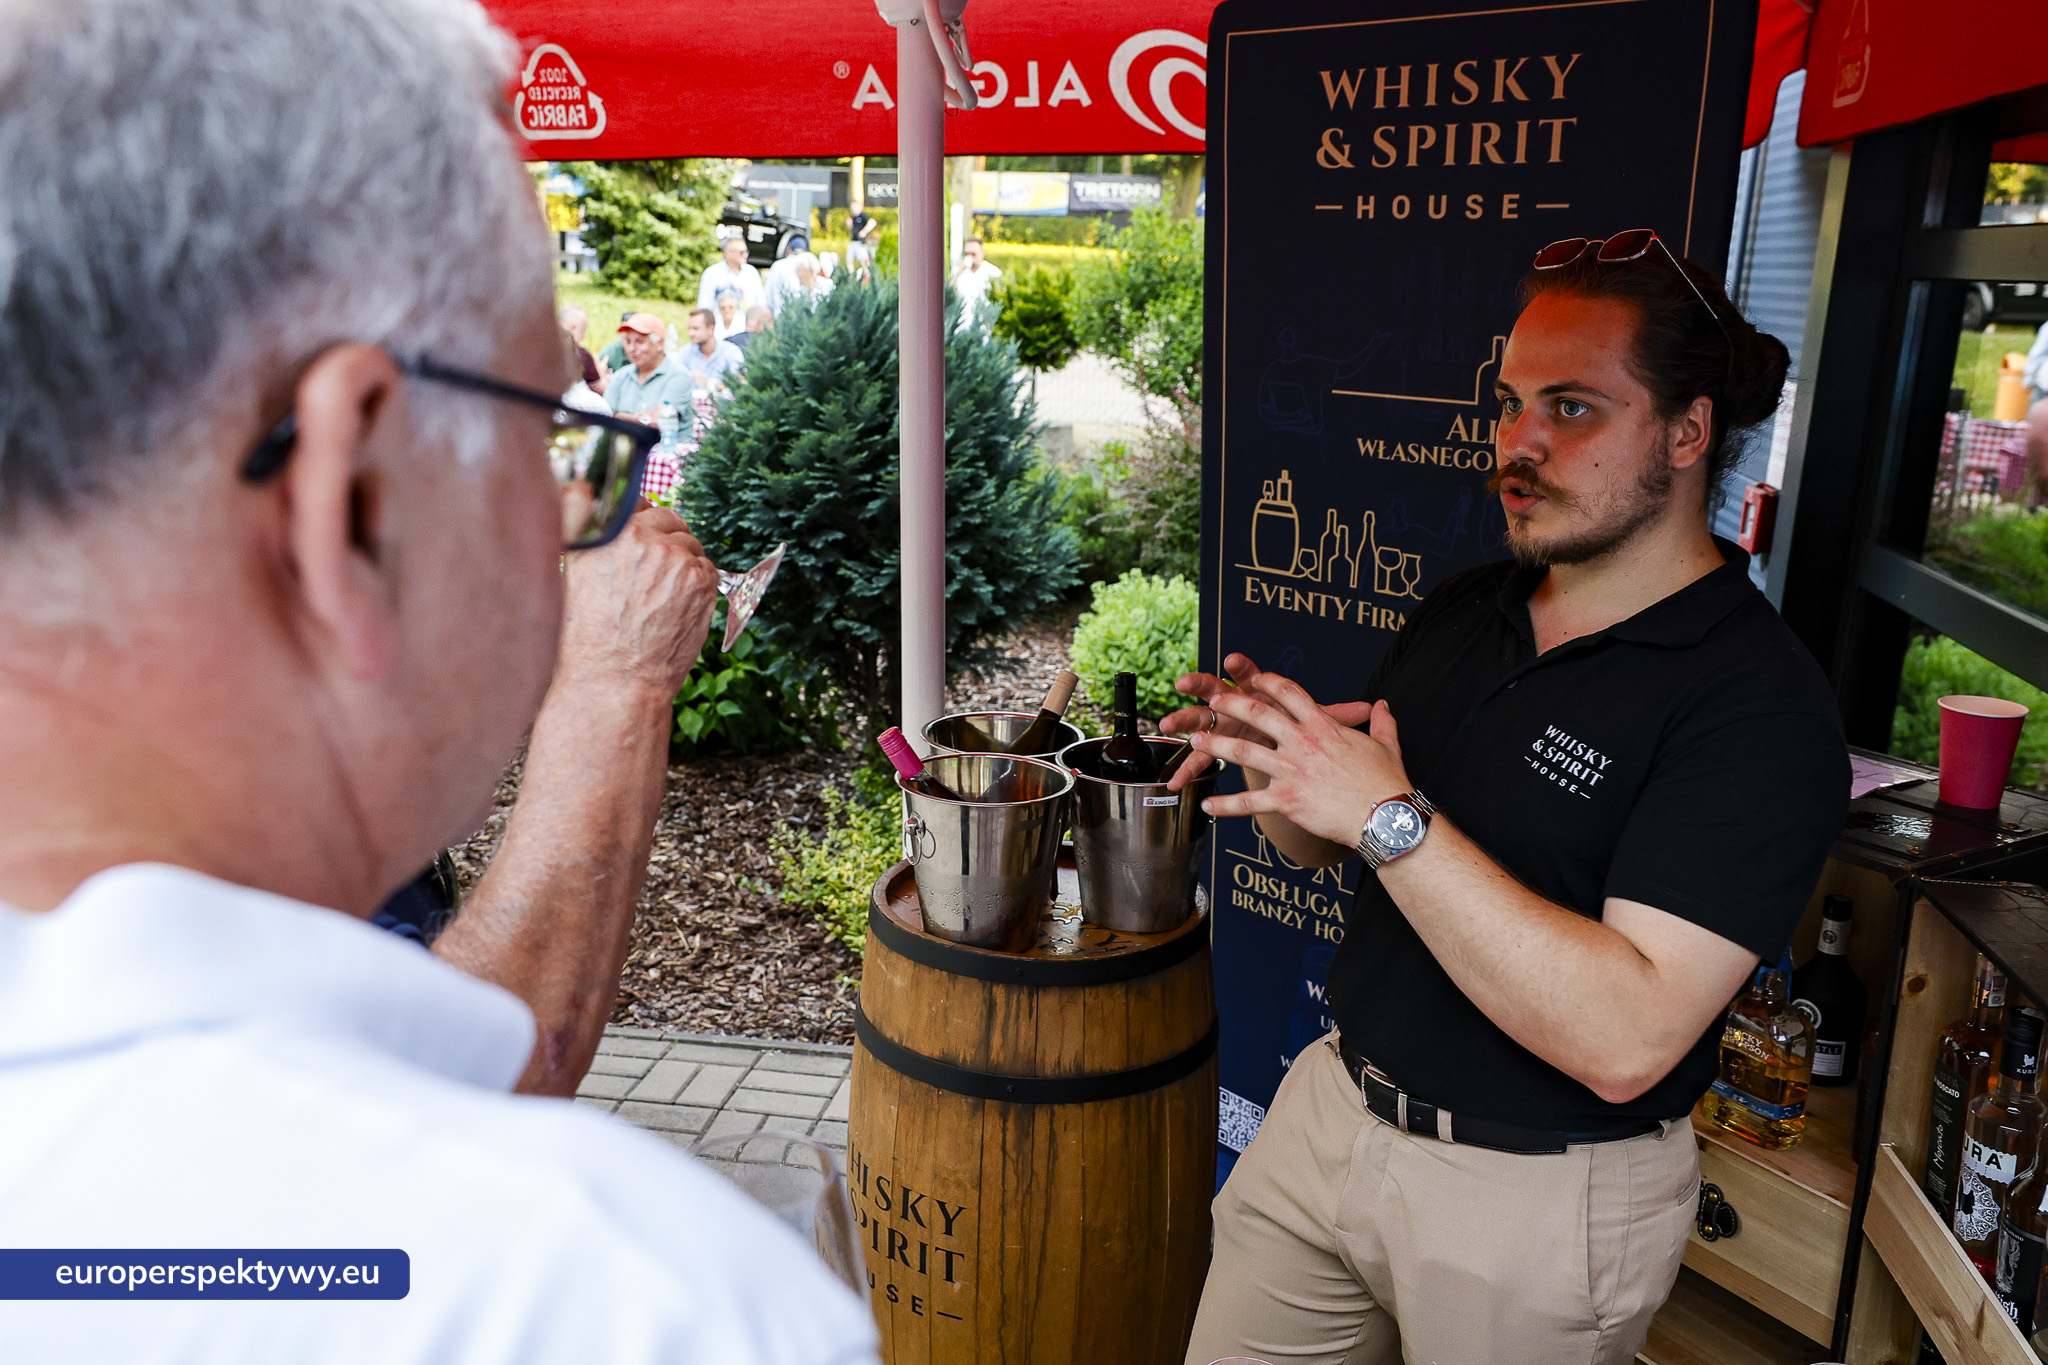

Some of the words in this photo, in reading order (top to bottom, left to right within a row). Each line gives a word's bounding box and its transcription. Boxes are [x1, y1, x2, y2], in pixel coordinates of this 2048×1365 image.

[1318, 53, 1584, 111] WHISKY
[1316, 127, 1355, 169] &
[1371, 117, 1577, 168] SPIRIT
[1356, 193, 1520, 219] HOUSE
[1356, 438, 1494, 472] WŁASNEGO
[1245, 576, 1351, 621] EVENTY
[1532, 739, 1545, 754] &
[1543, 746, 1604, 786] SPIRIT
[1544, 724, 1613, 770] WHISKY
[1531, 760, 1579, 793] HOUSE
[1232, 889, 1307, 929] BRANŻY
[1314, 920, 1345, 944] HO
[1233, 863, 1345, 923] OBSŁUGA
[850, 1141, 968, 1237] HISKY
